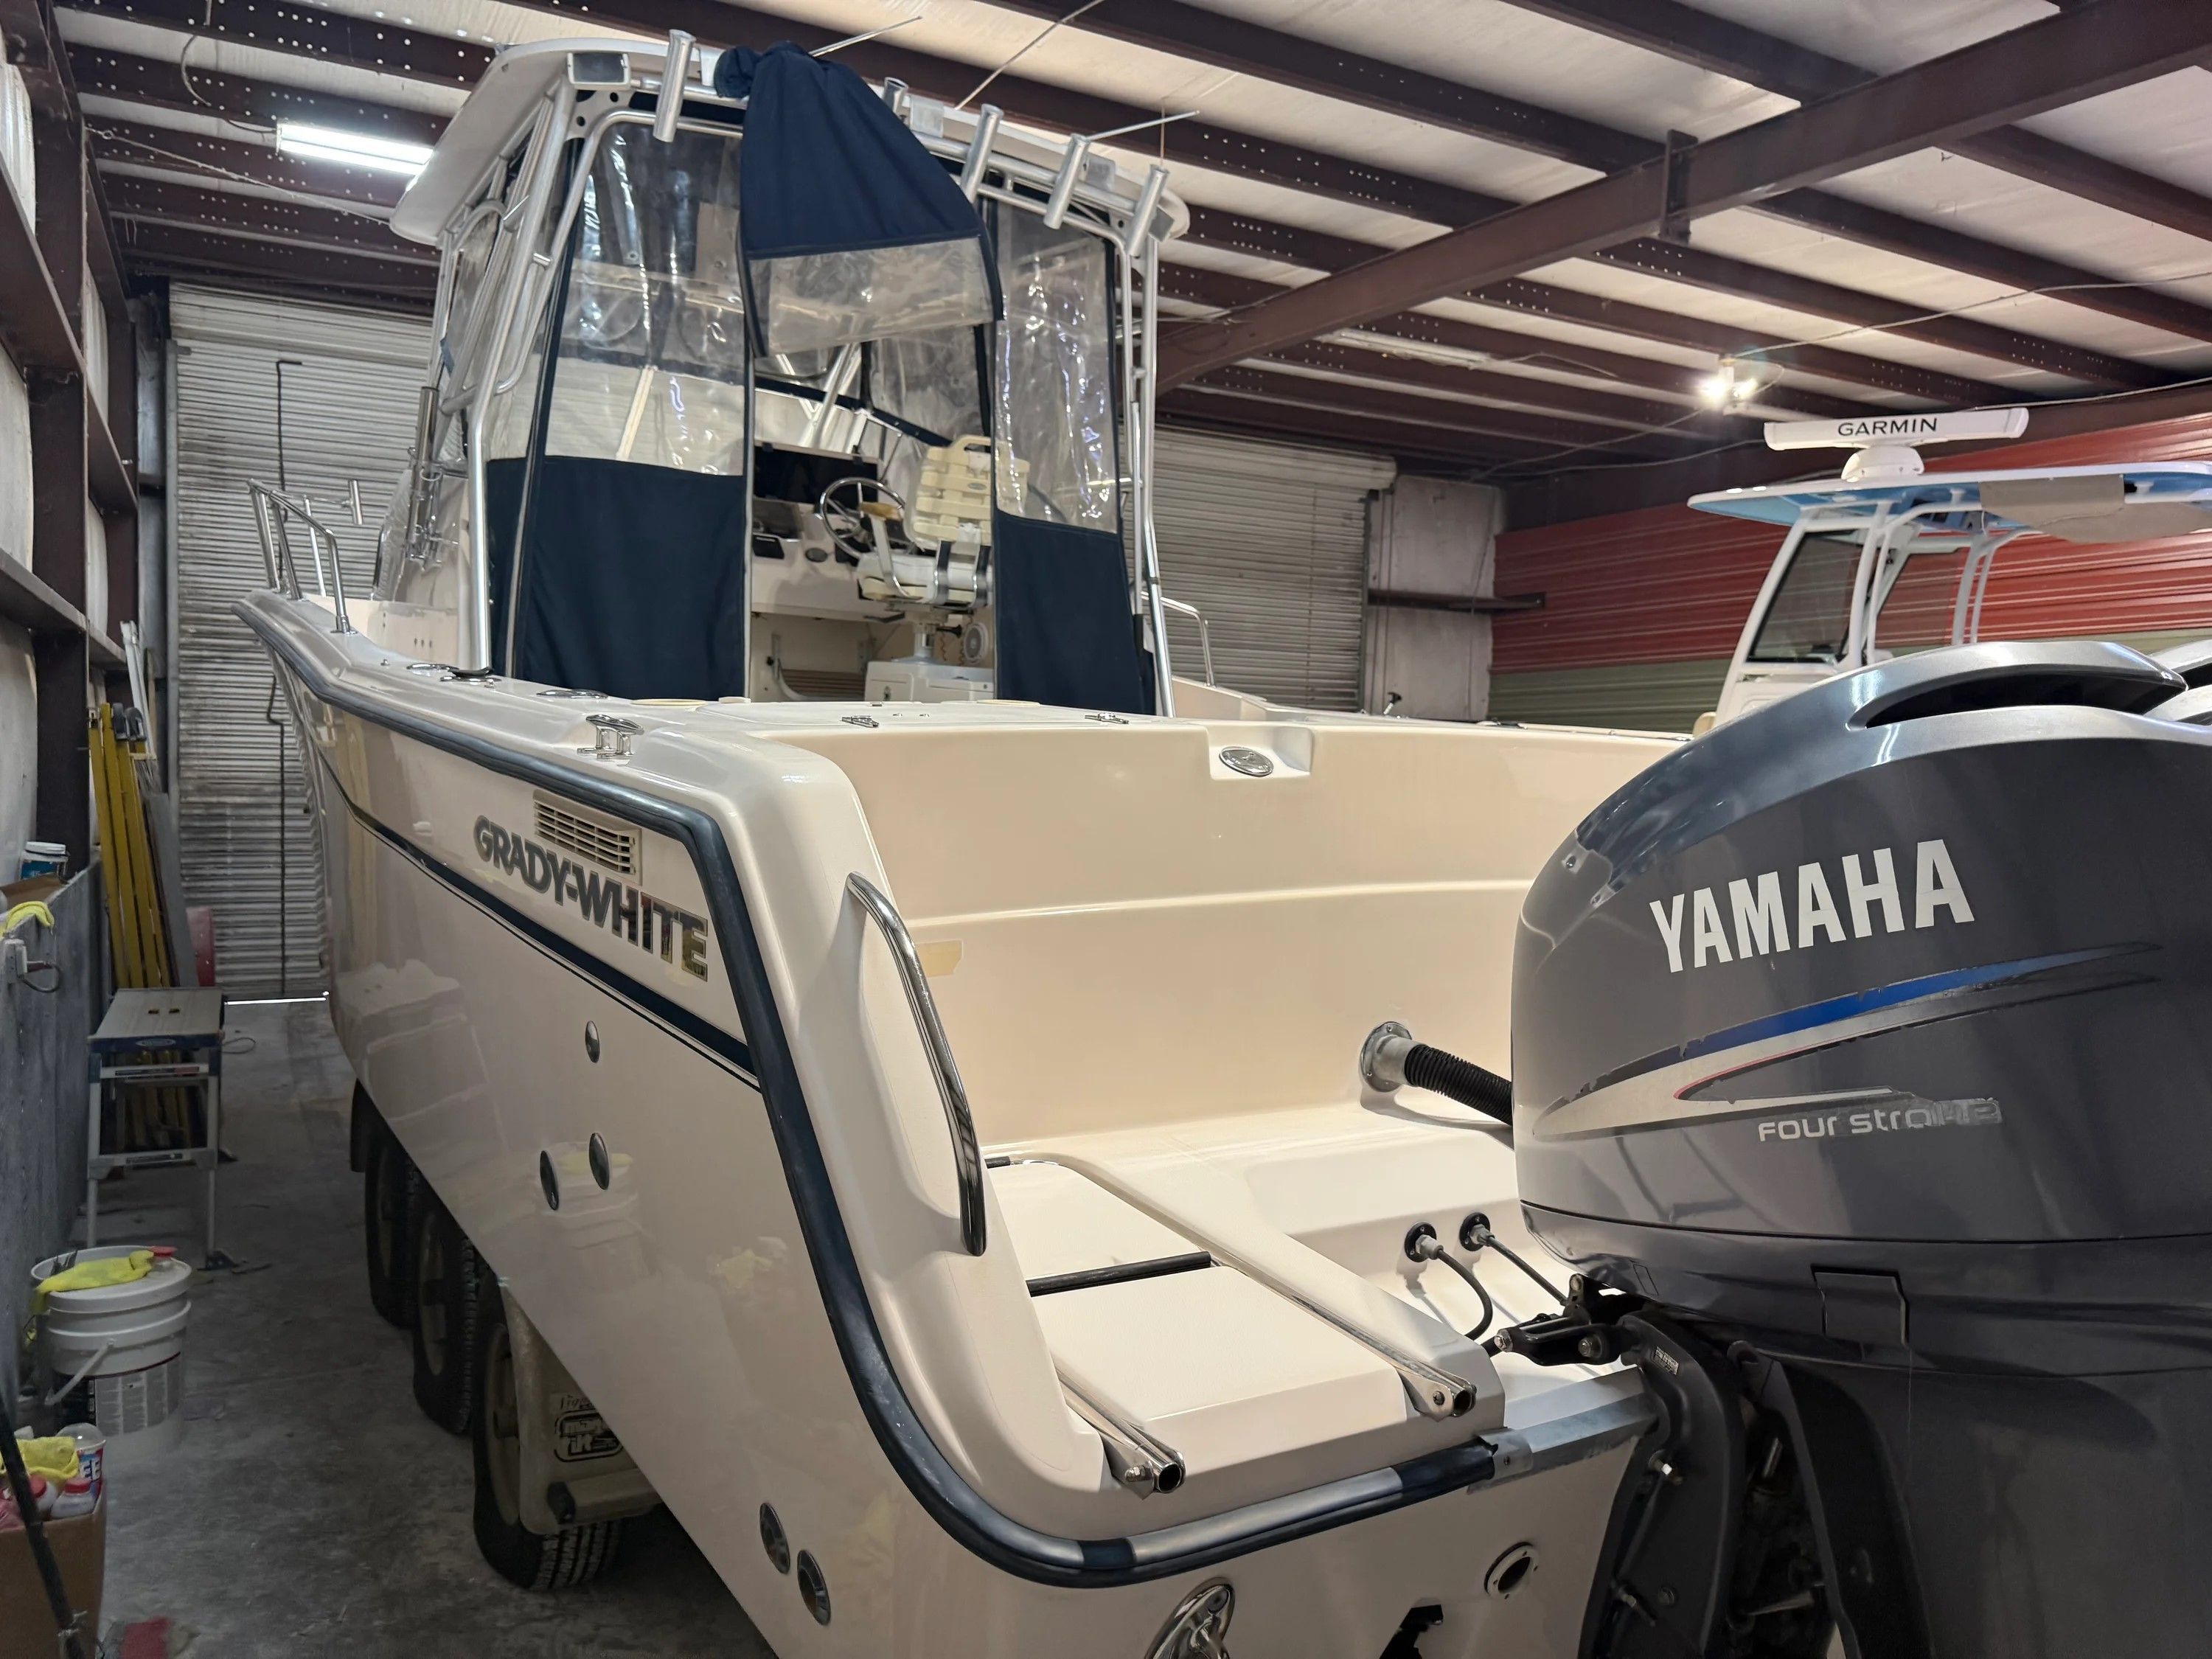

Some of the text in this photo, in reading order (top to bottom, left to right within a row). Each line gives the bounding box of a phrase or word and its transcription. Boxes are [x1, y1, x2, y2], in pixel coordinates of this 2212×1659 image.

[1837, 417, 1938, 437] GARMIN
[473, 815, 709, 982] GRADY-WHITE
[1649, 838, 1975, 973] YAMAHA
